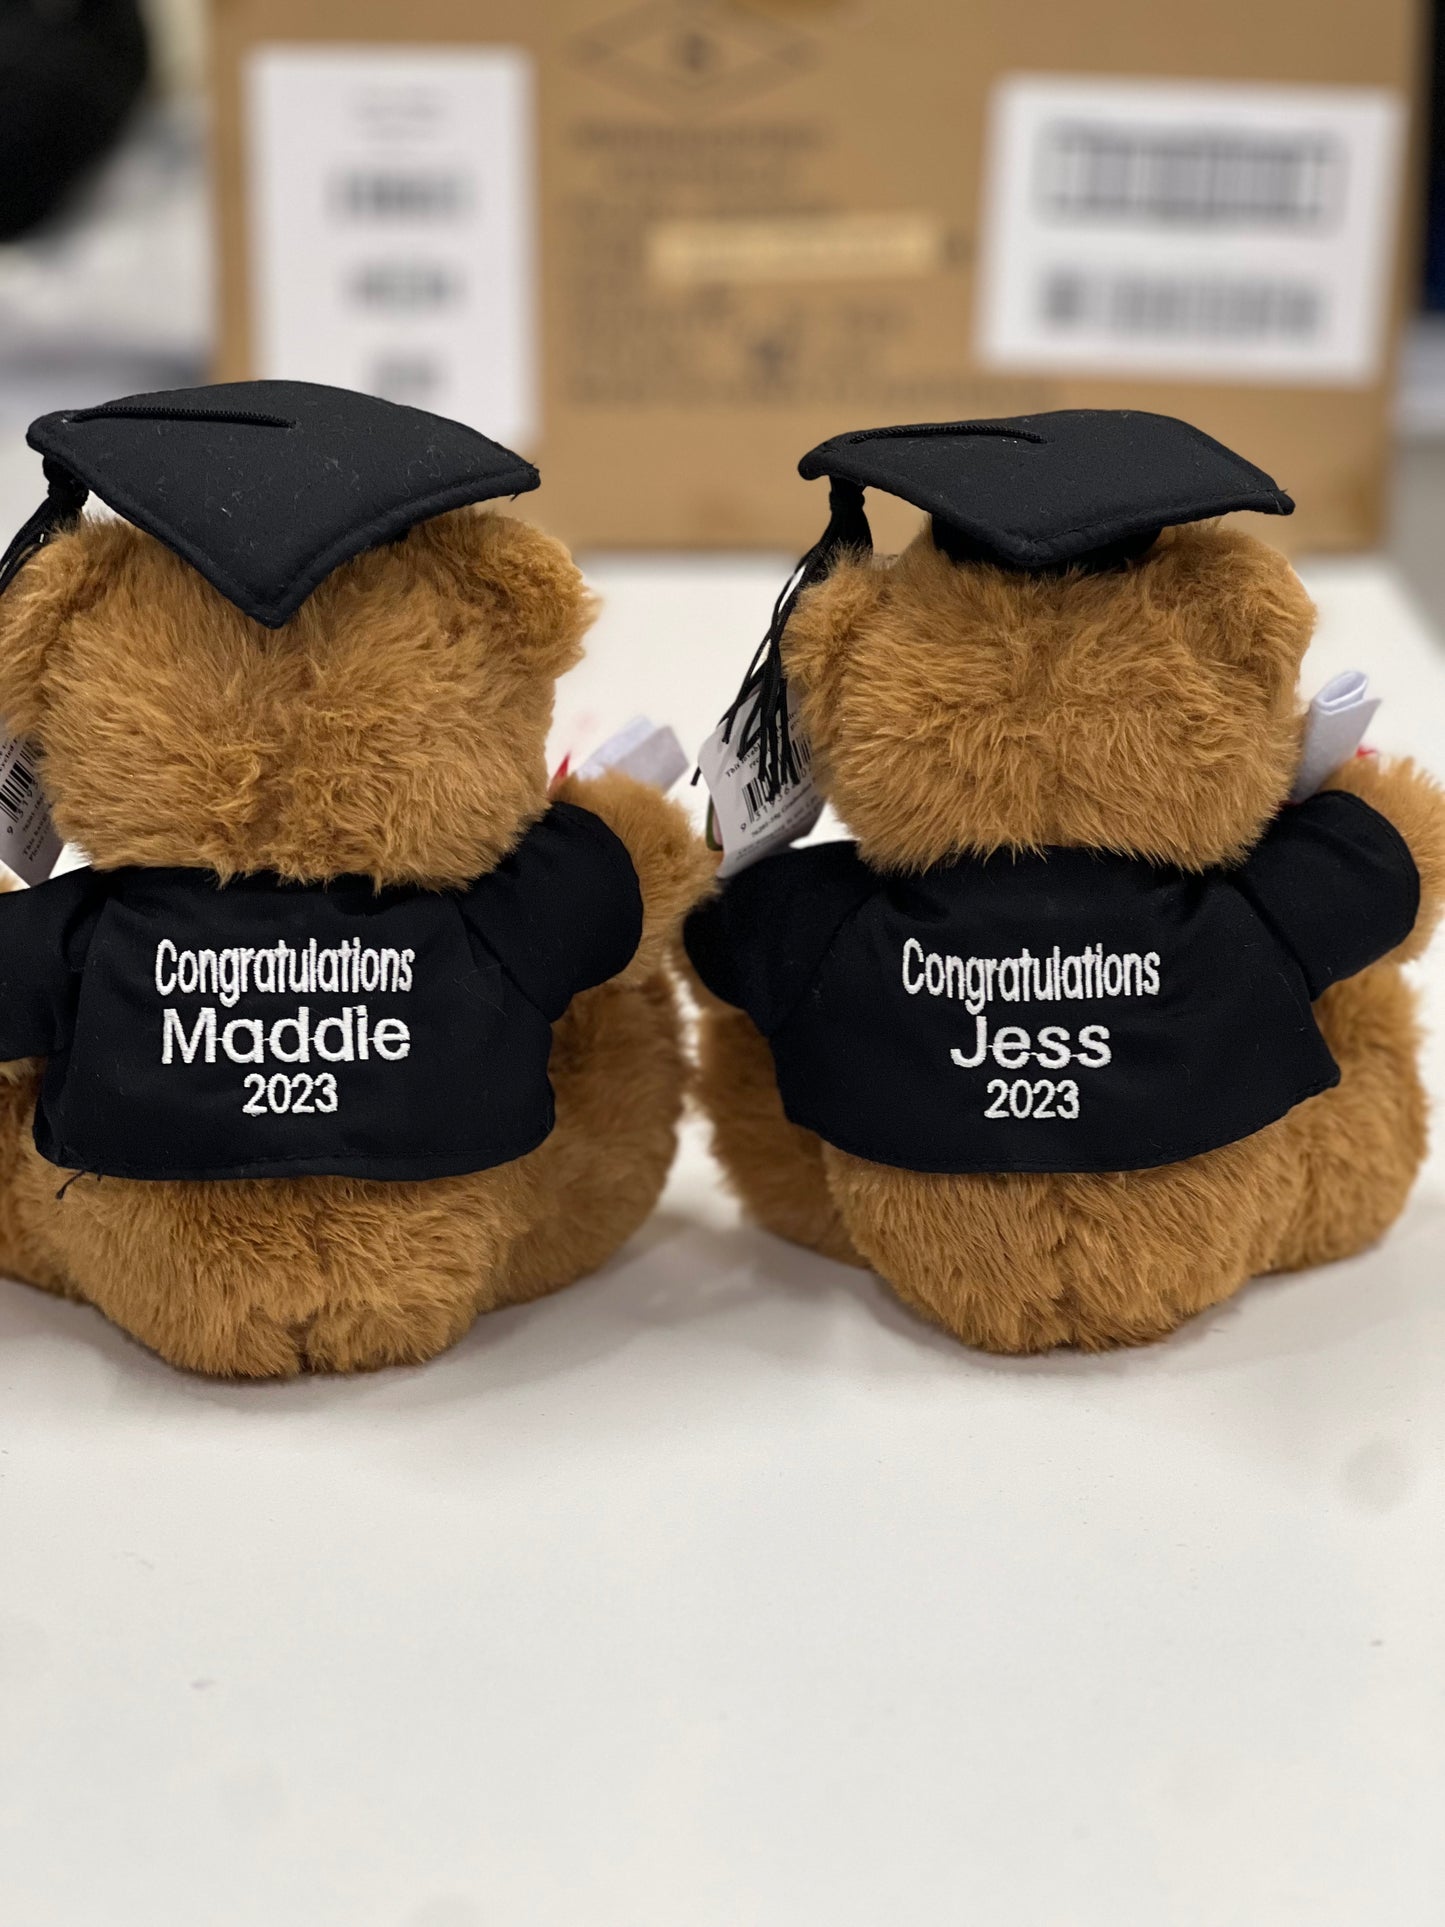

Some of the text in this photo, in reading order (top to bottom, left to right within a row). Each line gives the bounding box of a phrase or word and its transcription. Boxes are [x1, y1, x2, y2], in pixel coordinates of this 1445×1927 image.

[155, 937, 415, 1008] Congratulations
[902, 938, 1161, 1015] Congratulations
[161, 1005, 411, 1064] Maddie
[950, 1015, 1112, 1069] Jess
[242, 1072, 338, 1114] 2023
[984, 1079, 1080, 1119] 2023
